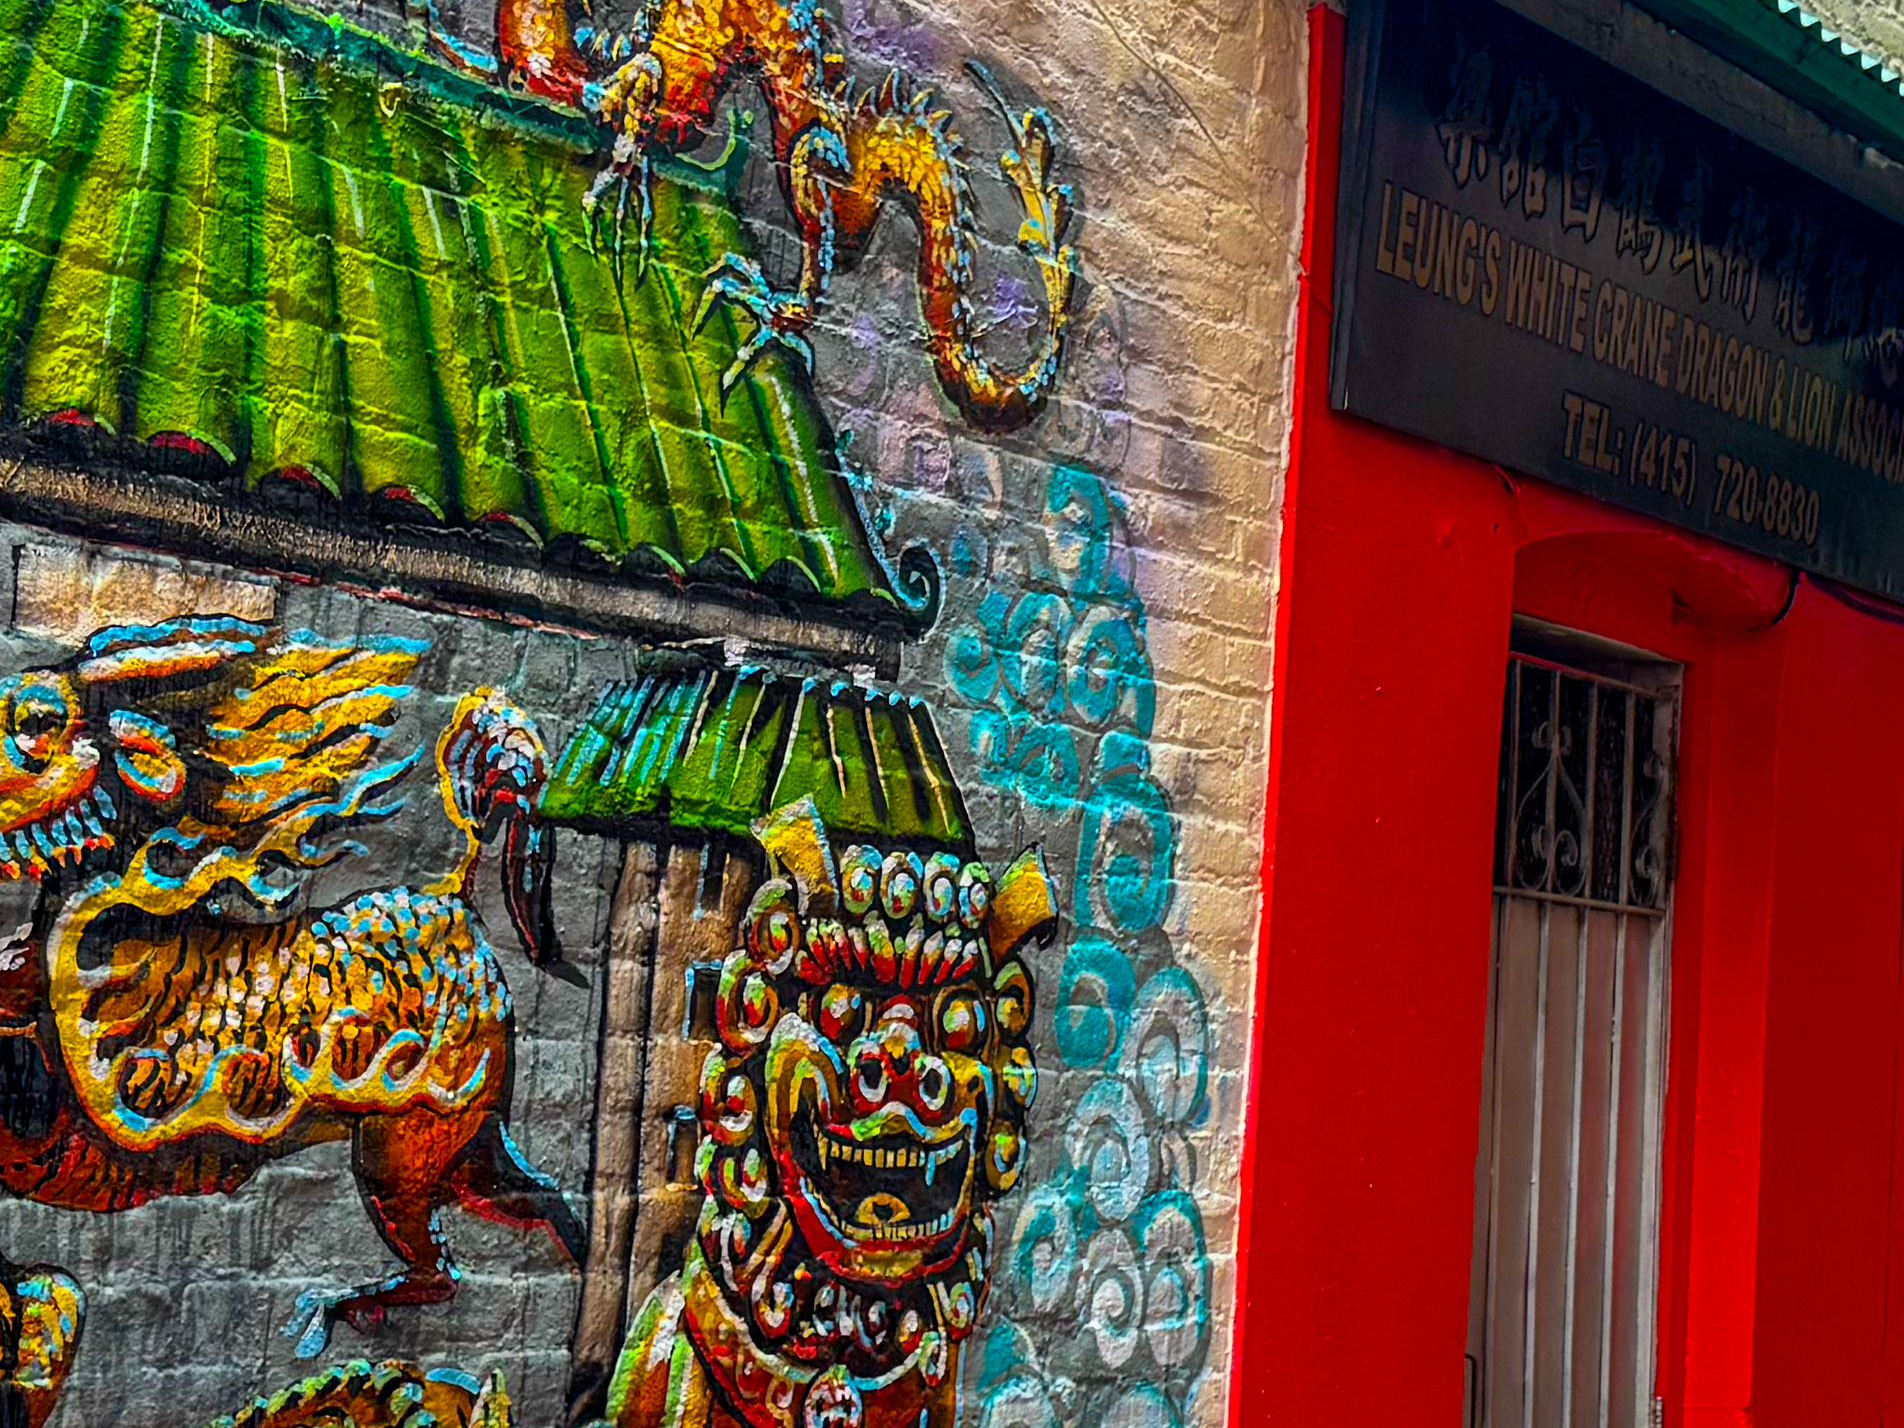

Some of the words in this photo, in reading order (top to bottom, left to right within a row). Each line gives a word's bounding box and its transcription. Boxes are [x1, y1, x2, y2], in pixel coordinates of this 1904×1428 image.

[1375, 179, 1502, 316] LEUNG'S
[1503, 236, 1592, 353] WHITE
[1593, 280, 1677, 395] CRANE
[1676, 320, 1768, 428] DRAGON
[1767, 367, 1786, 429] &
[1786, 369, 1836, 452] LION
[1561, 391, 1625, 478] TEL:
[1628, 423, 1697, 507] (415)
[1713, 452, 1820, 547] 720-8830
